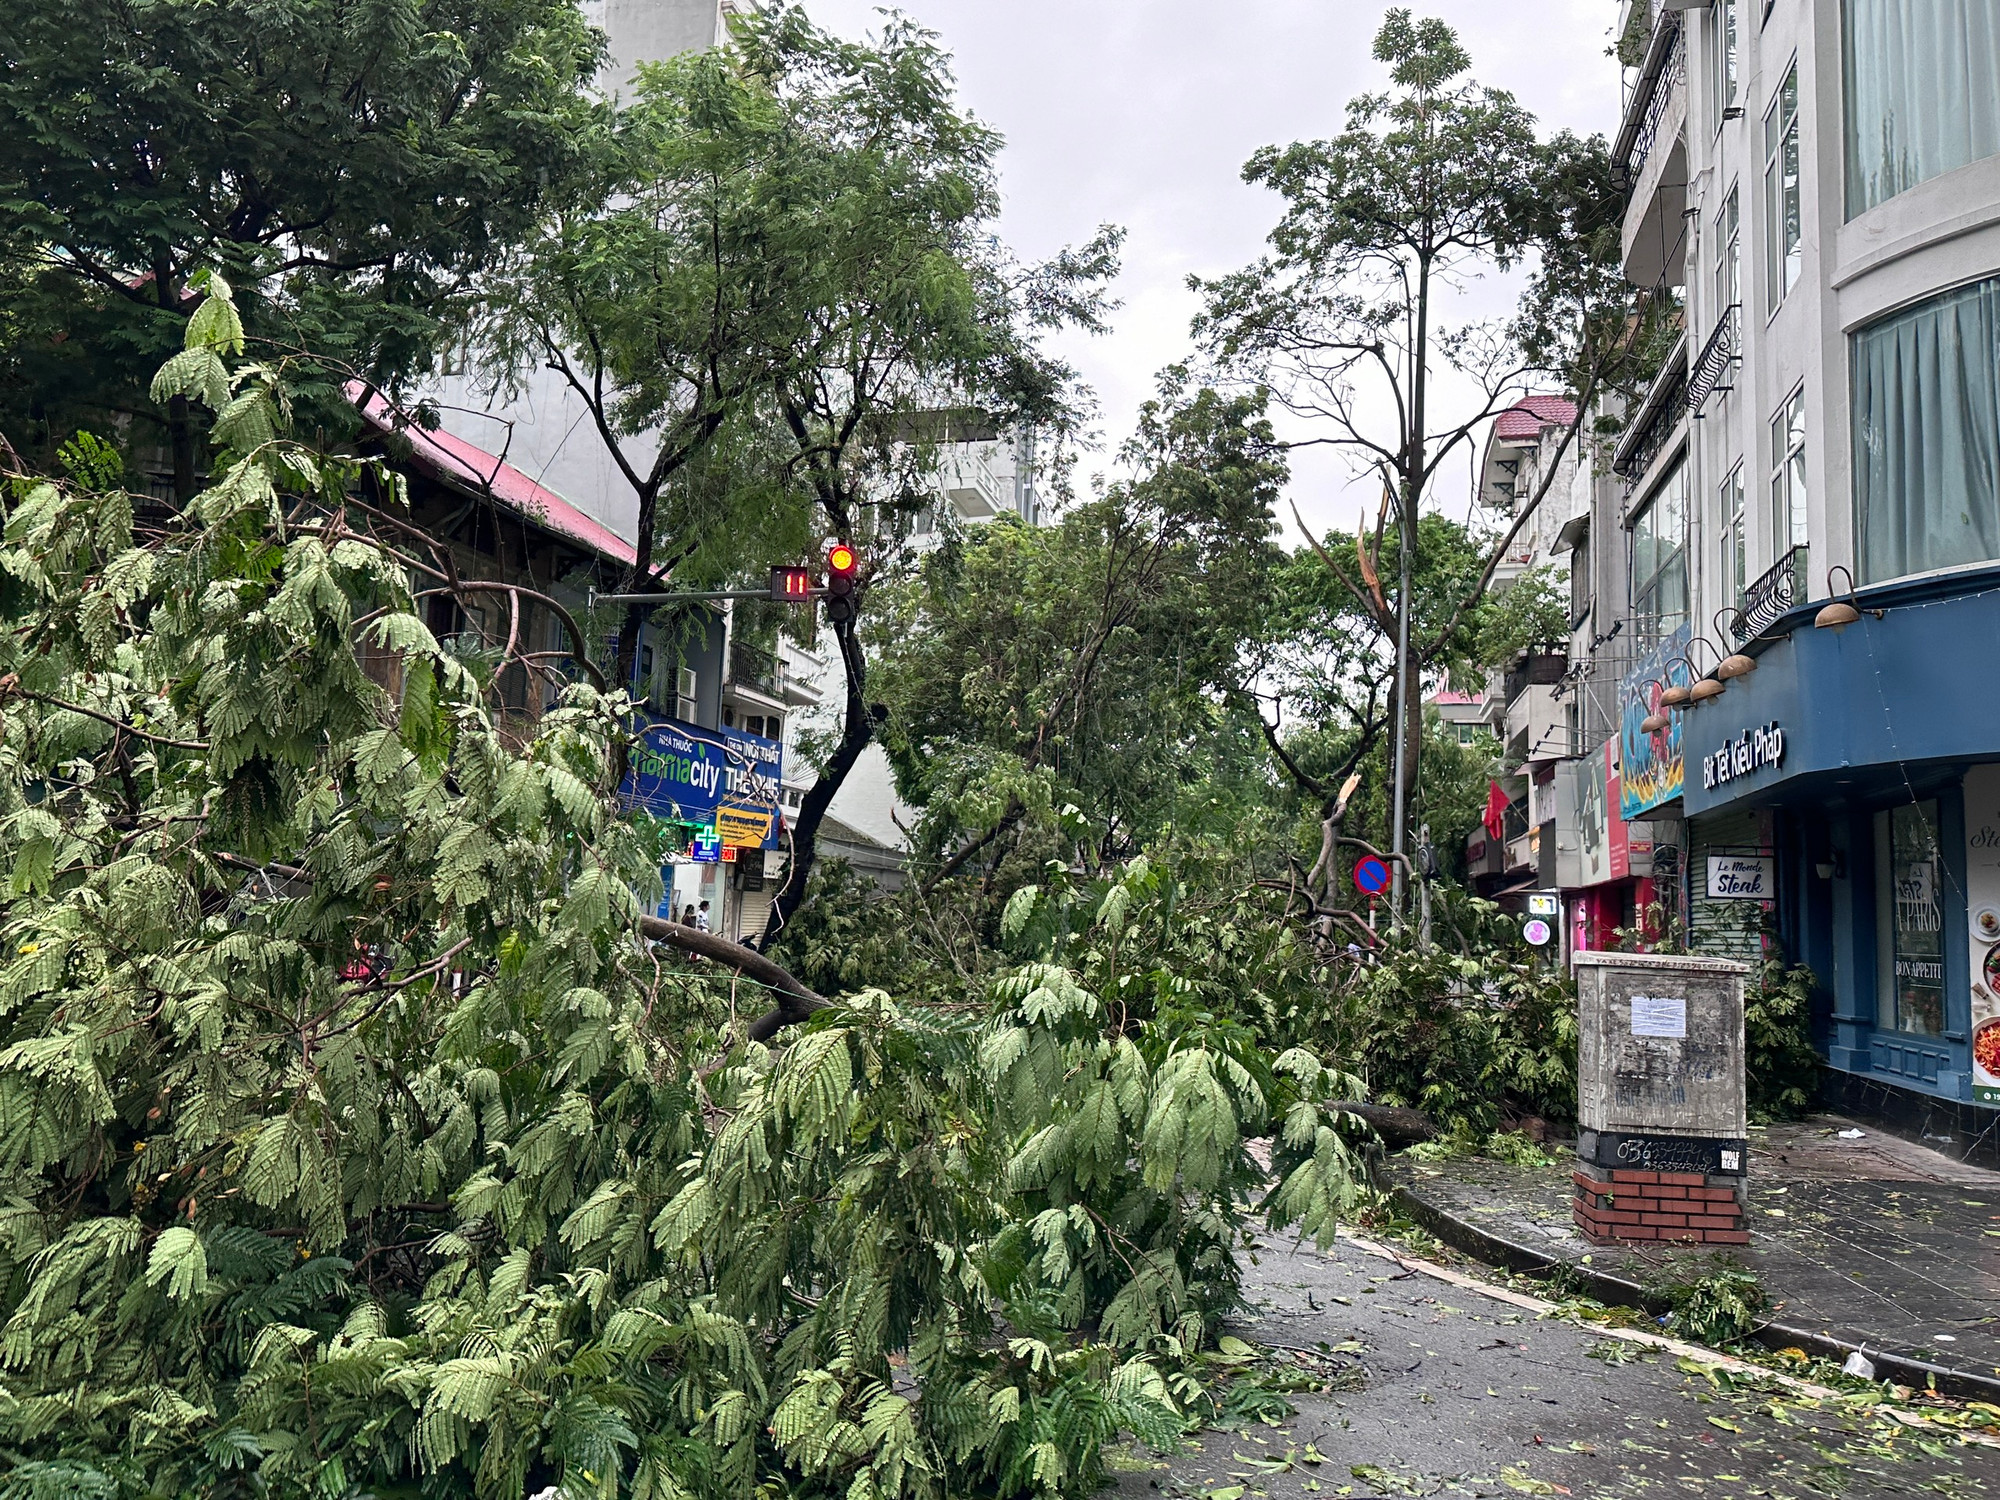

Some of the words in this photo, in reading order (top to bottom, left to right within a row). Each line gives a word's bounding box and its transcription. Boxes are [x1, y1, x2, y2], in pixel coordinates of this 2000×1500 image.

[786, 575, 804, 594] 11
[658, 733, 672, 747] NHÀ
[672, 738, 693, 753] THUỐC
[1754, 720, 1782, 768] Pháp
[628, 745, 720, 798] harmacity
[725, 766, 751, 794] THE
[1717, 861, 1730, 871] Le
[1732, 860, 1764, 872] Monde
[1717, 873, 1764, 894] Steak
[1721, 1150, 1740, 1160] WOLF
